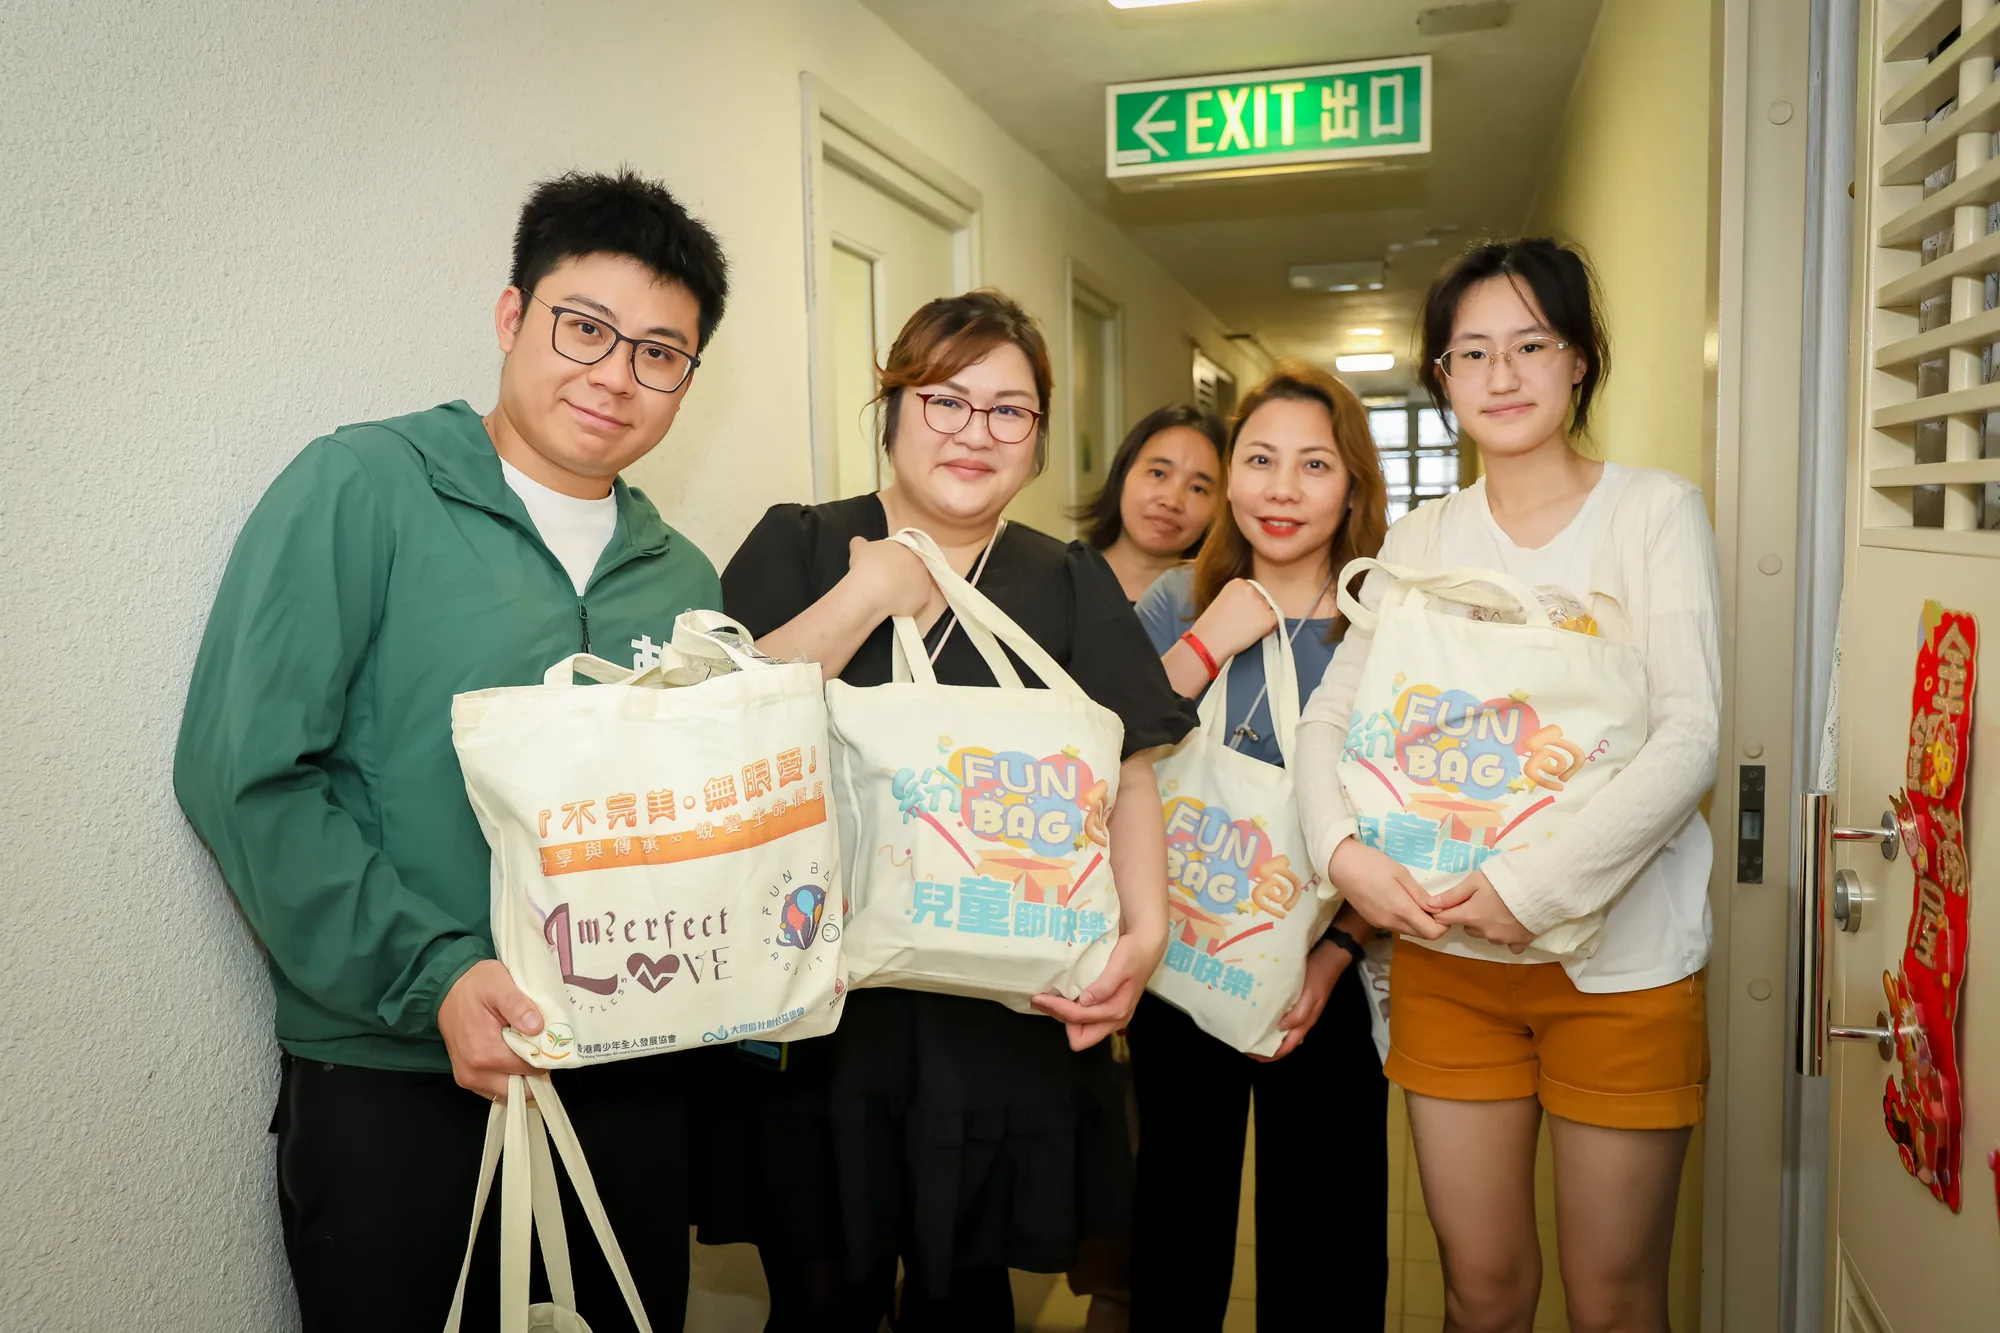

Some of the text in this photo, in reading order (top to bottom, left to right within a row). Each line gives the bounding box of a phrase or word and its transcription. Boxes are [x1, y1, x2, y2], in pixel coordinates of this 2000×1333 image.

[1186, 74, 1405, 154] EXIT 出口
[1401, 693, 1520, 746] FUN
[963, 753, 1079, 802] FUN
[1404, 743, 1506, 788] BAG
[969, 798, 1074, 845] BAG
[1166, 802, 1258, 870] FUN
[910, 875, 1109, 946] 兒童節快樂
